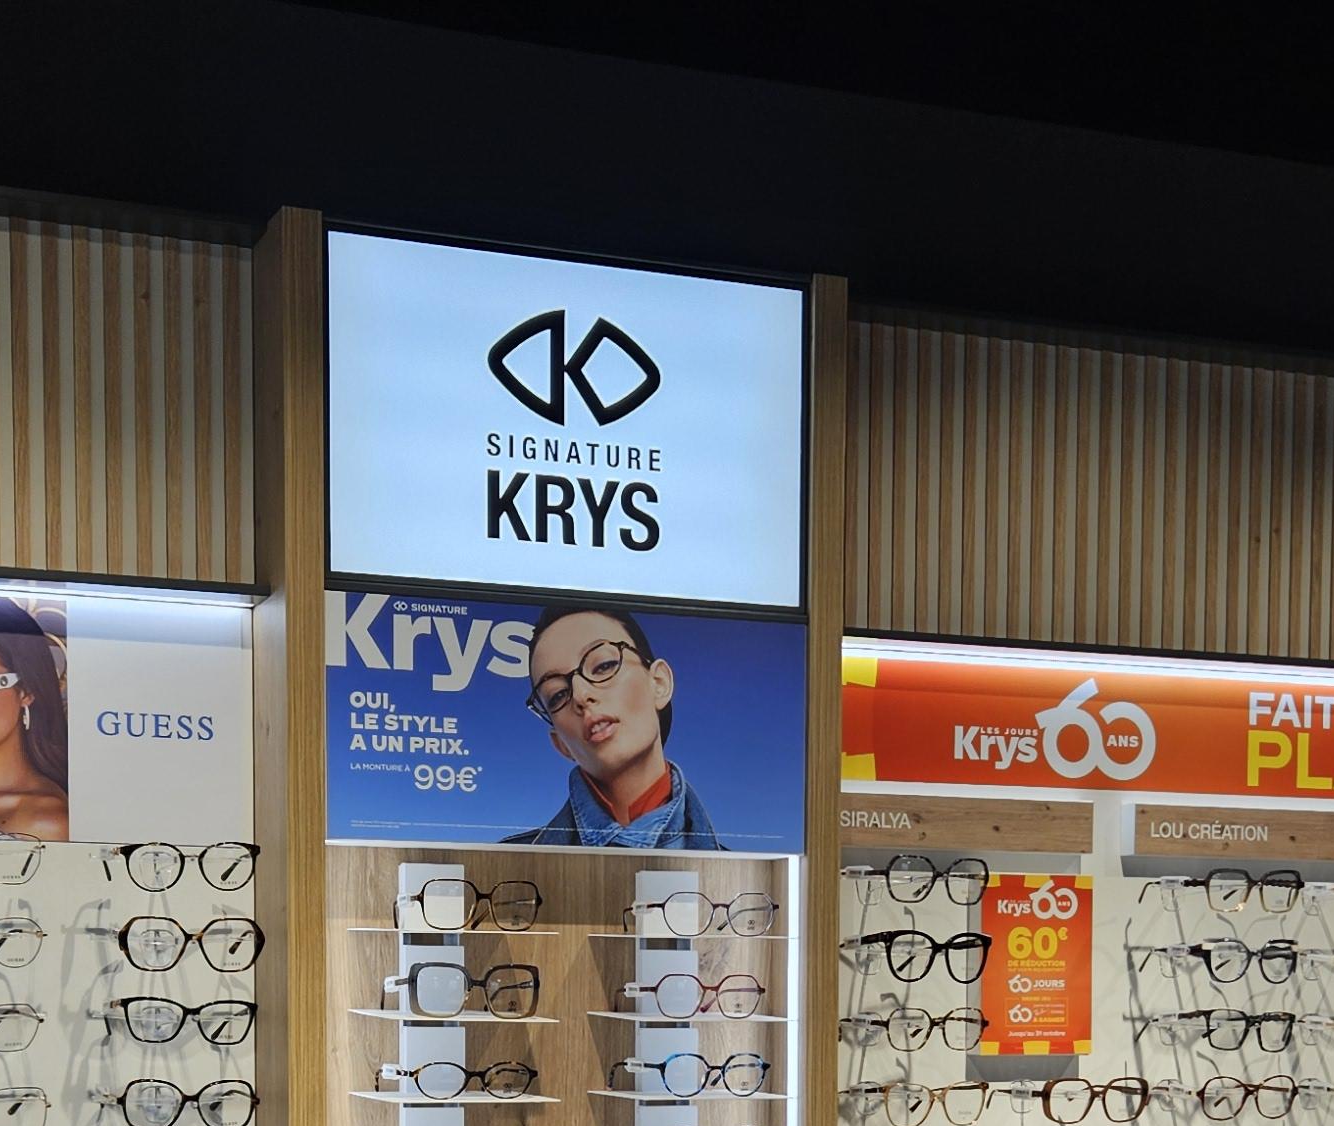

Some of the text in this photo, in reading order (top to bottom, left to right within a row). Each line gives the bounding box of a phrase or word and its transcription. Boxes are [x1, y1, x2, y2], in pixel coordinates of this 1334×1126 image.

[487, 432, 662, 472] SIGNATURE
[486, 469, 660, 552] KRYS
[411, 603, 468, 615] SIGNATURE
[324, 590, 536, 692] Krys
[350, 691, 395, 712] OUI,
[96, 711, 215, 741] GUESS
[351, 712, 458, 734] LE STYLE
[954, 677, 1156, 780] Krys 60
[980, 727, 1038, 736] LES JOURS
[350, 734, 469, 755] A UN PRIX.
[1107, 735, 1139, 748] ANS
[362, 763, 403, 772] MONTURE
[839, 811, 912, 830] SIRALYA
[1150, 818, 1268, 842] LOU CRÉATION
[997, 899, 1031, 917] Krys
[1033, 979, 1065, 988] JOURS
